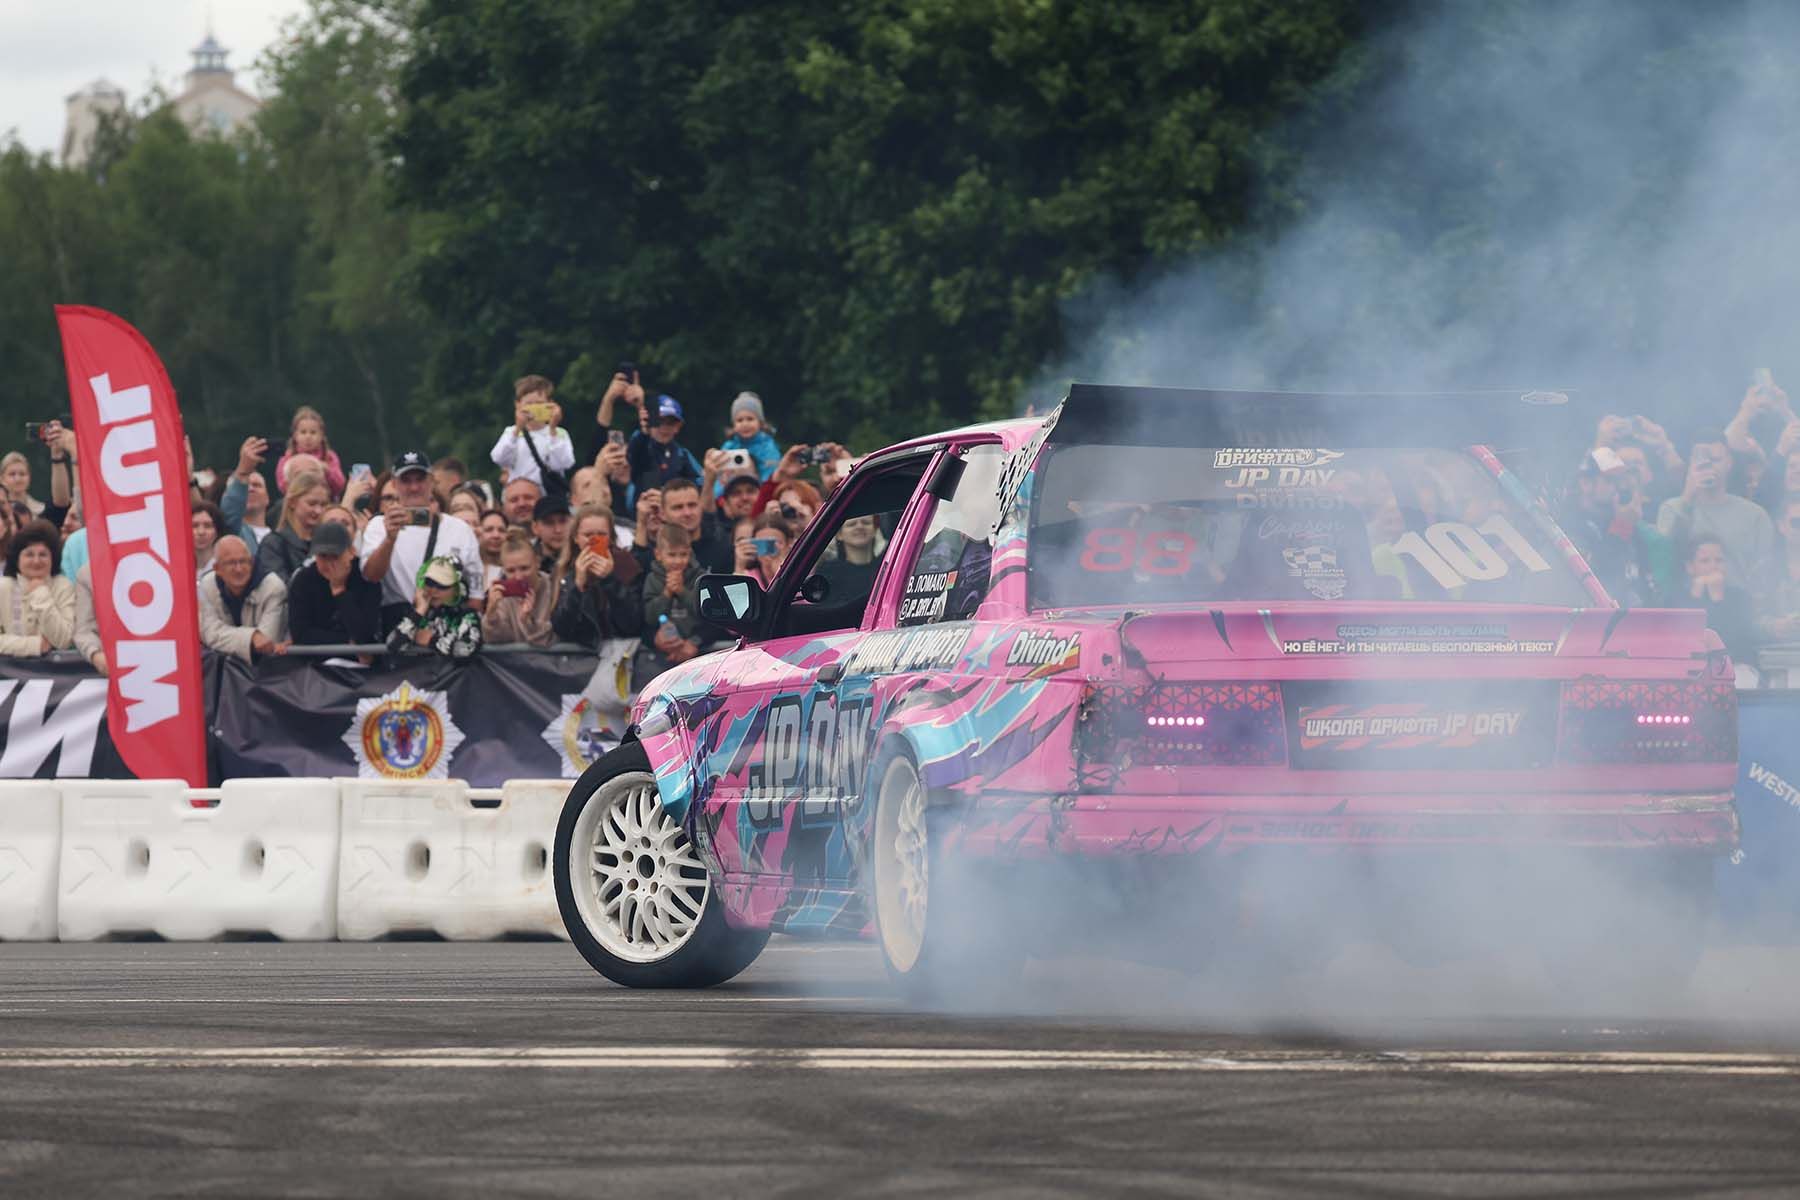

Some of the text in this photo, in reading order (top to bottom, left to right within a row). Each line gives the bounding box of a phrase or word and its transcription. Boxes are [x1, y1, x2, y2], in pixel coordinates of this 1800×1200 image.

[1224, 467, 1336, 488] JP DAY
[1079, 528, 1196, 576] 88
[1392, 513, 1552, 589] 101
[1007, 631, 1080, 665] Divinol
[1284, 641, 1301, 653] НО
[1302, 639, 1316, 653] ЕЁ
[1346, 641, 1356, 653] И
[1357, 641, 1375, 653] ТЫ
[1376, 641, 1430, 653] ЧИТАЕШЬ
[1431, 639, 1518, 653] БЕСПОЛЕЗНЫЙ
[1519, 641, 1554, 653] ТЕКСТ
[1306, 711, 1522, 737] ШКОЛА ДРИФТА JP DAY
[748, 700, 874, 821] JP DAY
